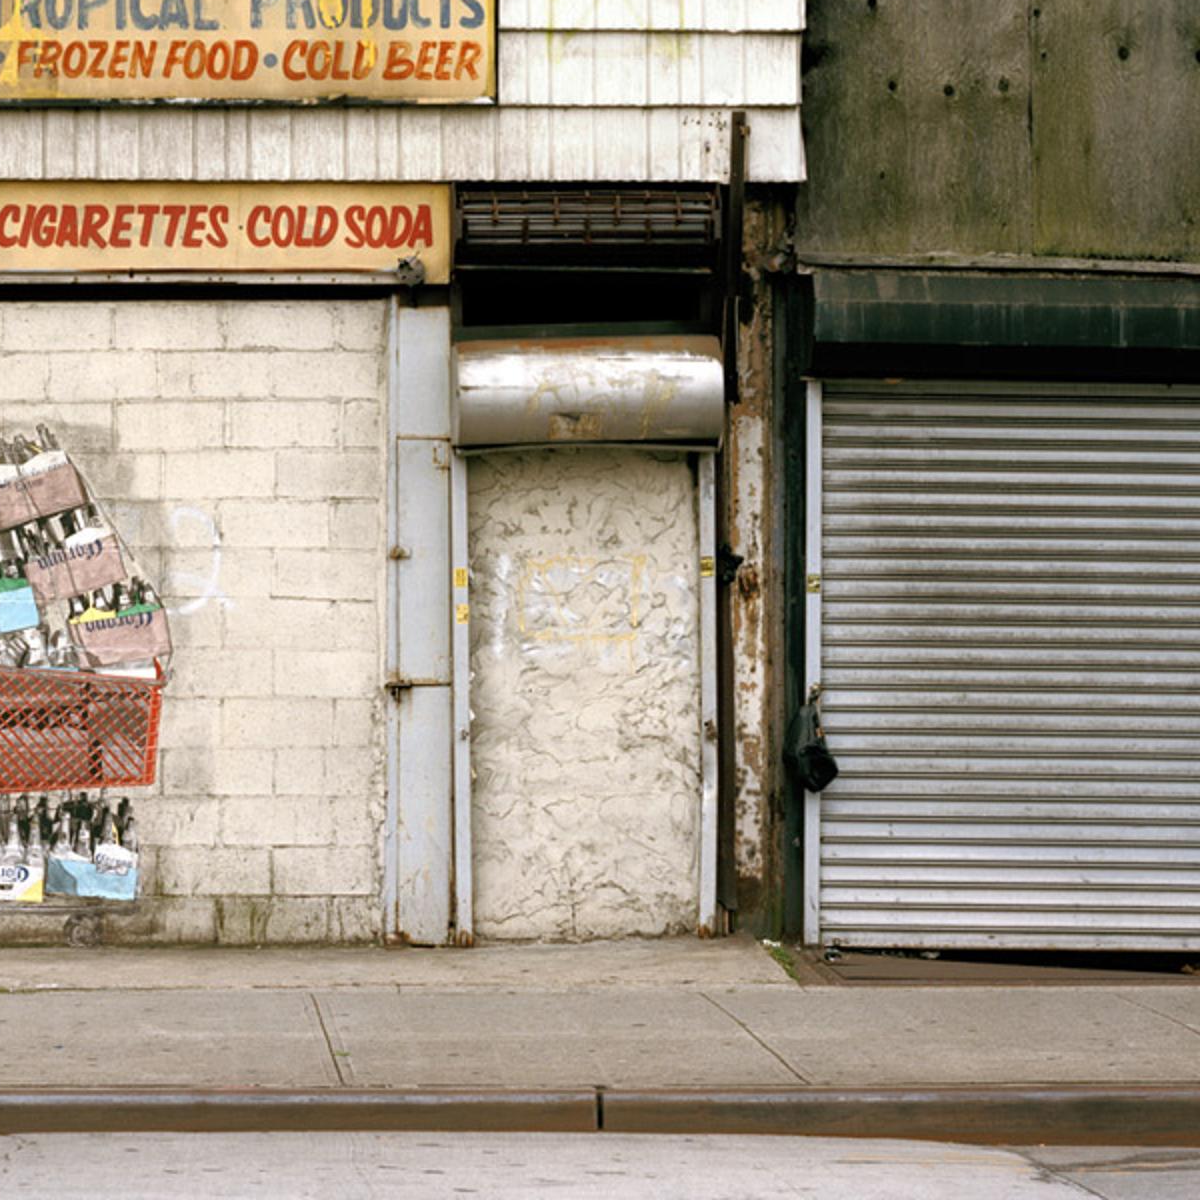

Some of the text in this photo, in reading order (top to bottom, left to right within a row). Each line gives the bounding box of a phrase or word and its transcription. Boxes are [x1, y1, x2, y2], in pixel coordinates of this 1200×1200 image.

[16, 39, 157, 80] FROZEN
[163, 39, 259, 80] FOOD
[281, 39, 379, 81] COLD
[382, 40, 483, 81] BEER
[246, 204, 338, 249] COLD
[344, 204, 434, 249] SODA
